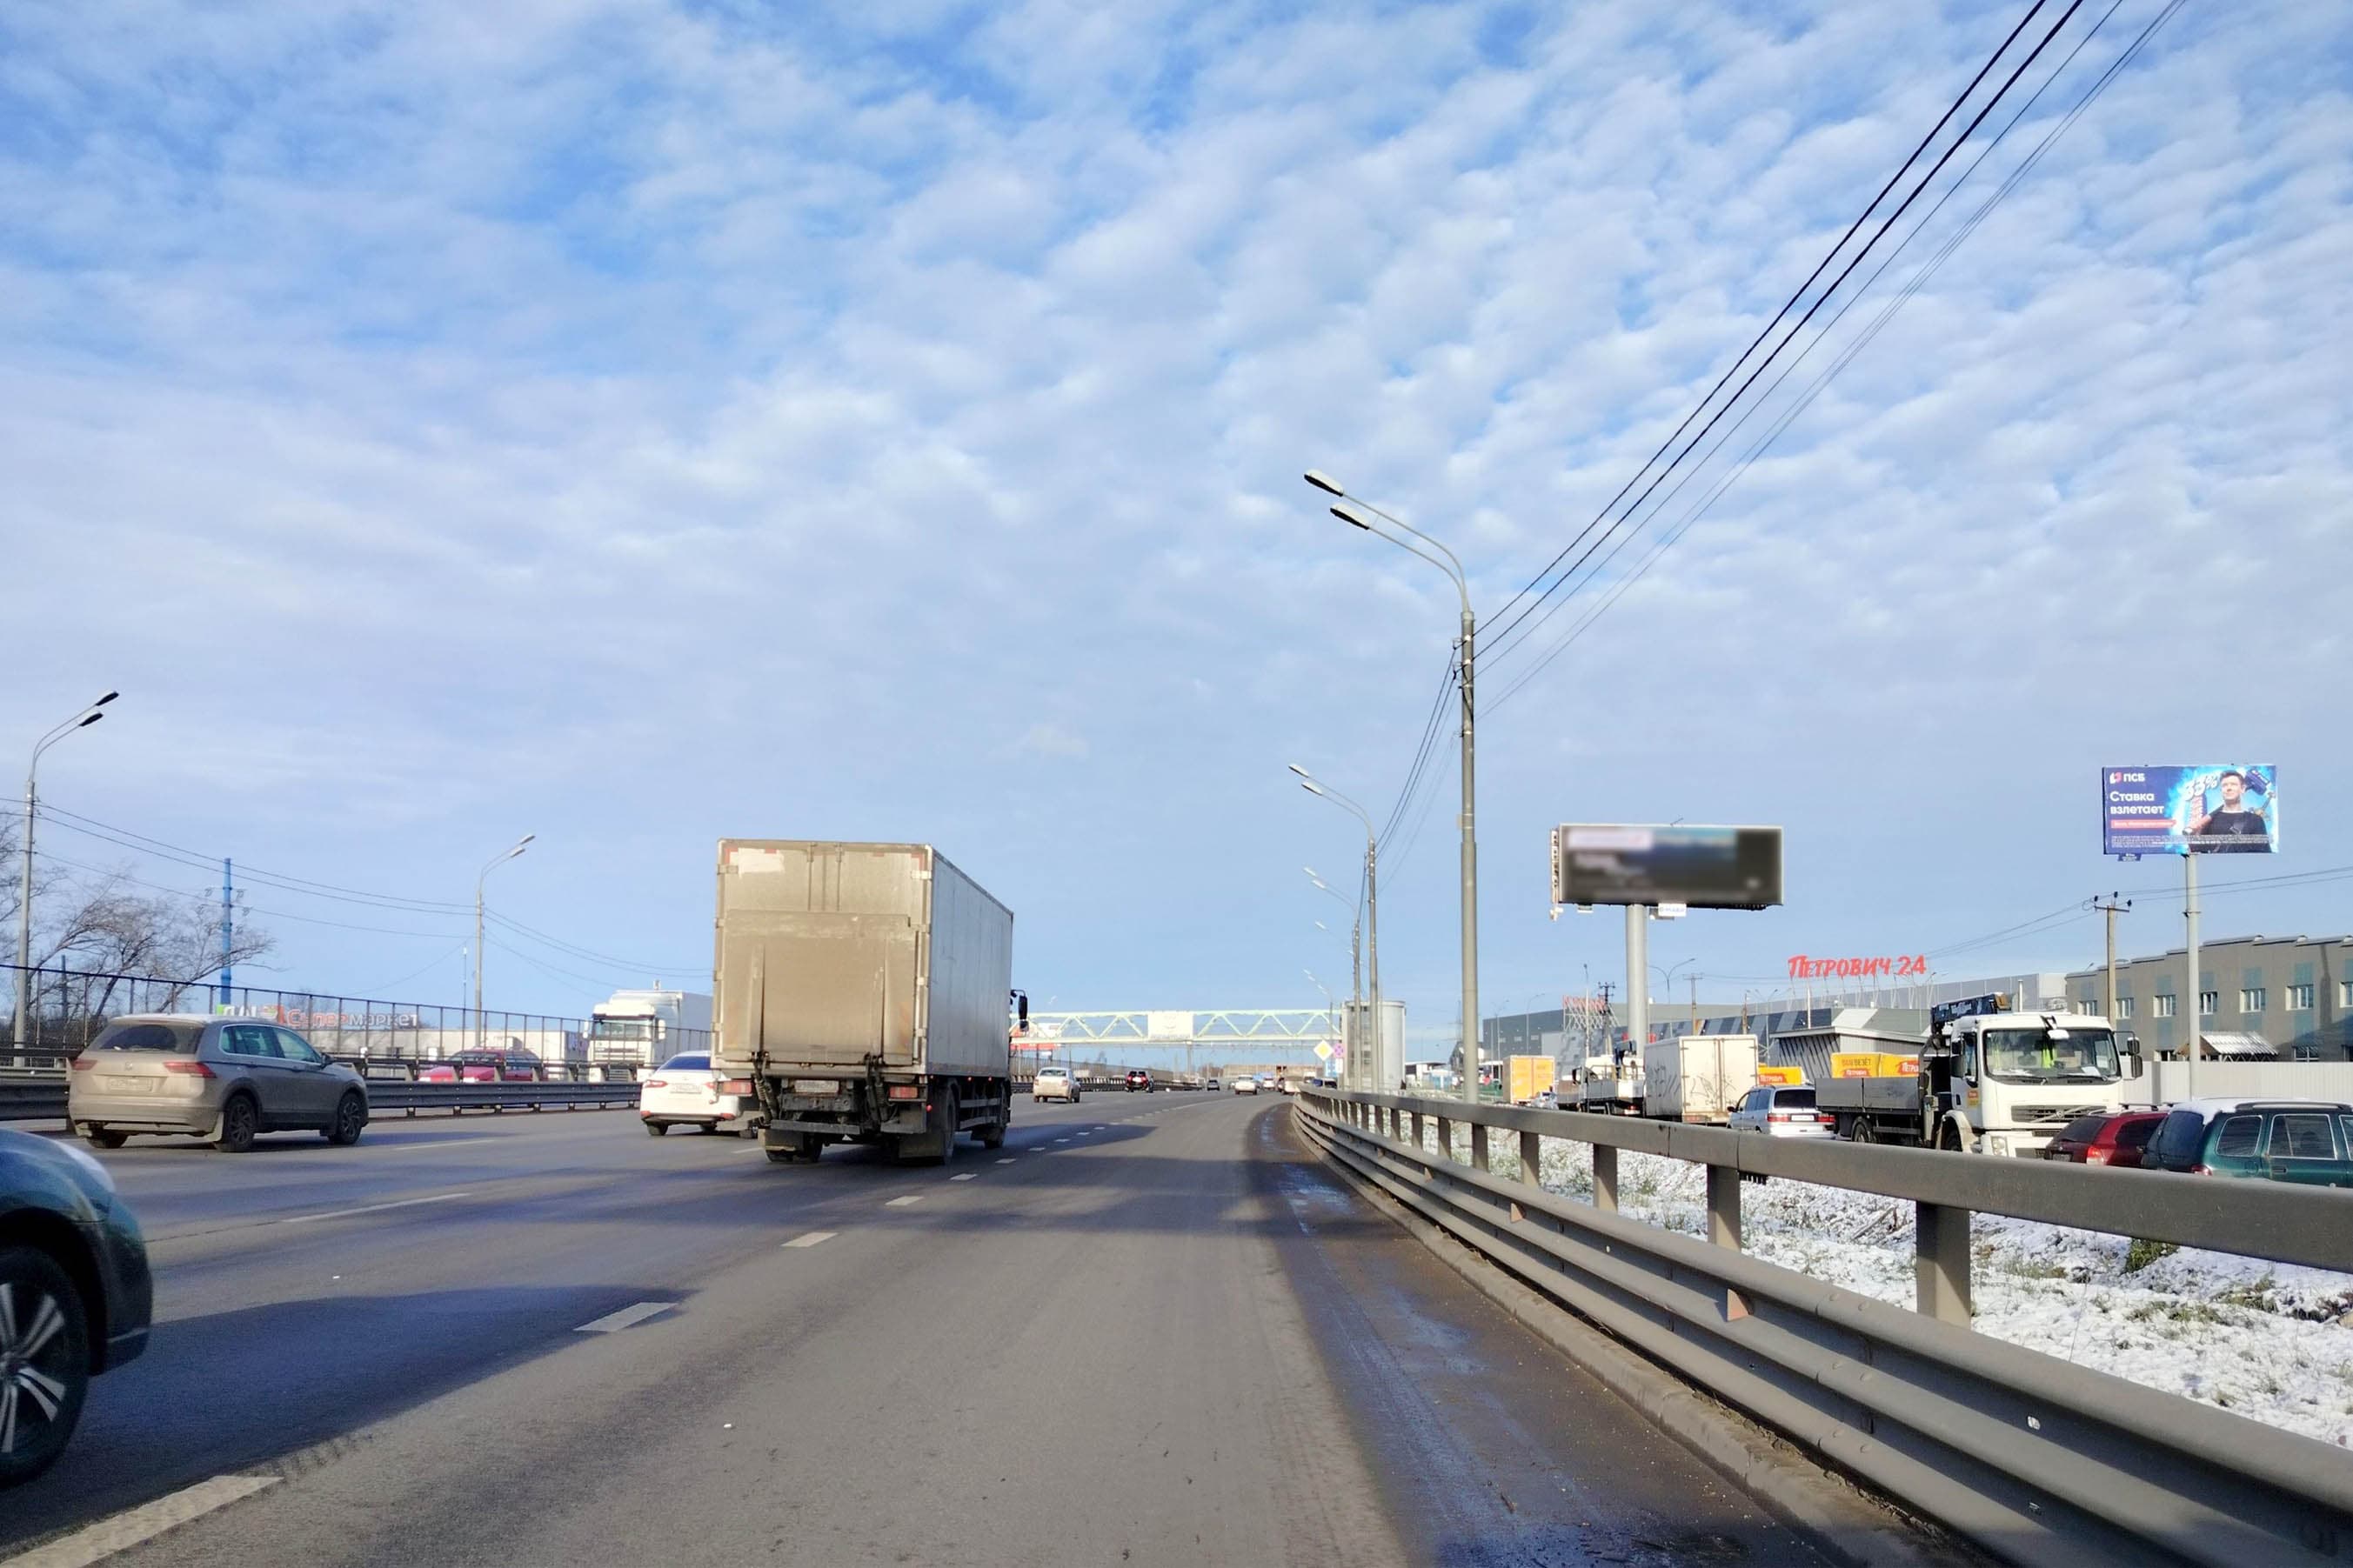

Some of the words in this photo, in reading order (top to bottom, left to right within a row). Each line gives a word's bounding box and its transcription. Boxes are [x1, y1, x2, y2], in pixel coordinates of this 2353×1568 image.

[2123, 772, 2145, 783] ПСБ
[2109, 791, 2155, 802] Ставка
[2110, 805, 2164, 815] взлетает
[1897, 954, 1927, 976] 24
